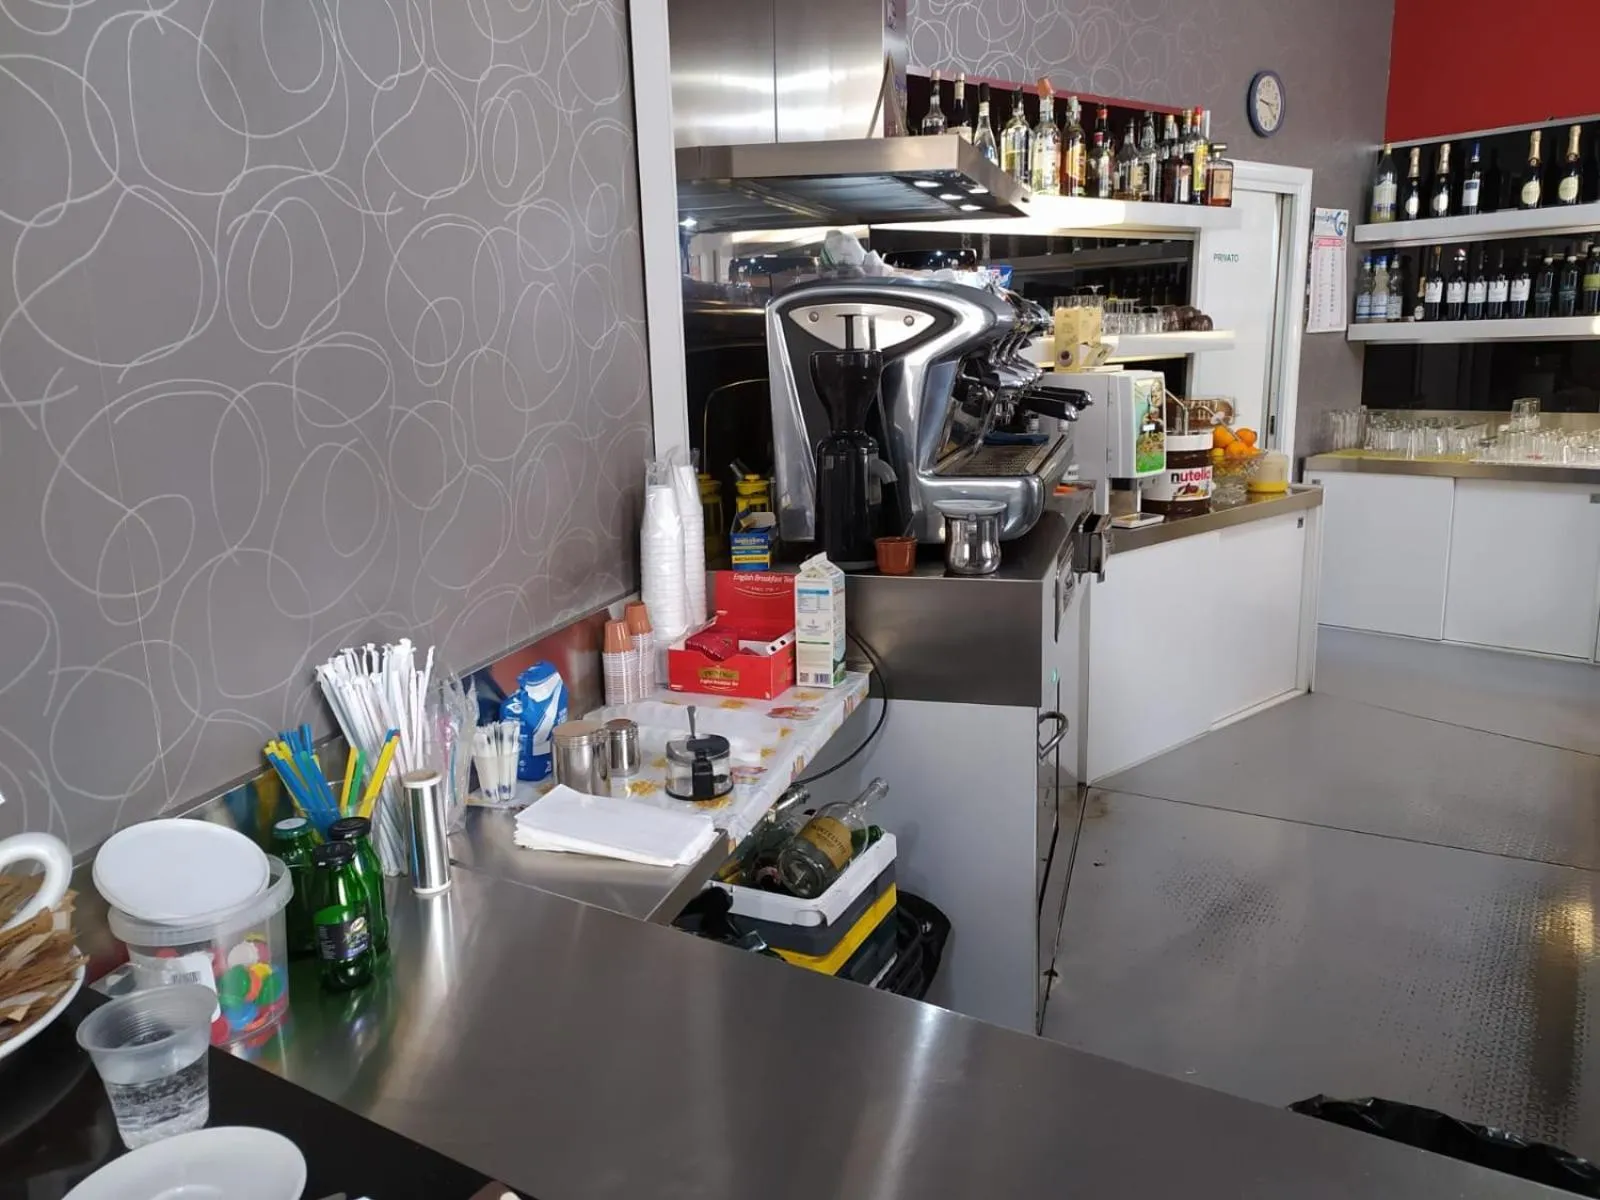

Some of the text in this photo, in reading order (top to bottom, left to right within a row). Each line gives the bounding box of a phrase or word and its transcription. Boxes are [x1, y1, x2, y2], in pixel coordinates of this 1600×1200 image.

[1213, 253, 1240, 263] PRIVATO
[733, 573, 754, 583] English
[754, 574, 783, 584] Breakfast
